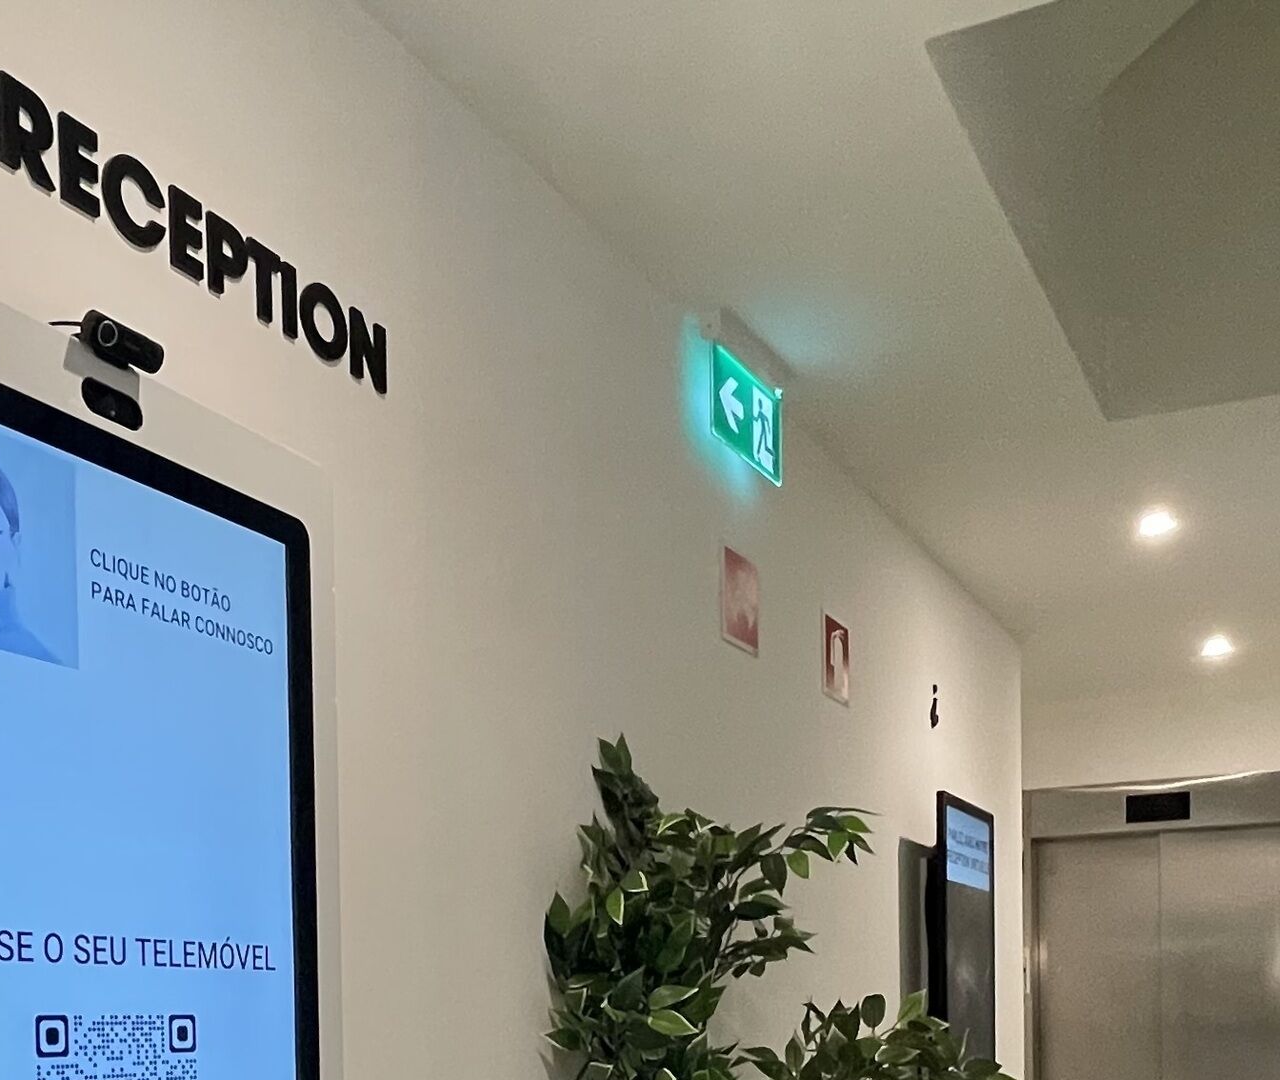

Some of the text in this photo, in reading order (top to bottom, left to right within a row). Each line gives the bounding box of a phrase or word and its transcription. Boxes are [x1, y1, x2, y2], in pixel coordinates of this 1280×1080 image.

[90, 549, 230, 612] CLIQUE NO BOTÃO
[91, 581, 273, 655] PARA FALAR CONNOSCO
[43, 932, 64, 964] O
[73, 933, 128, 966] SEU
[135, 937, 276, 970] TELEMÓVEL
